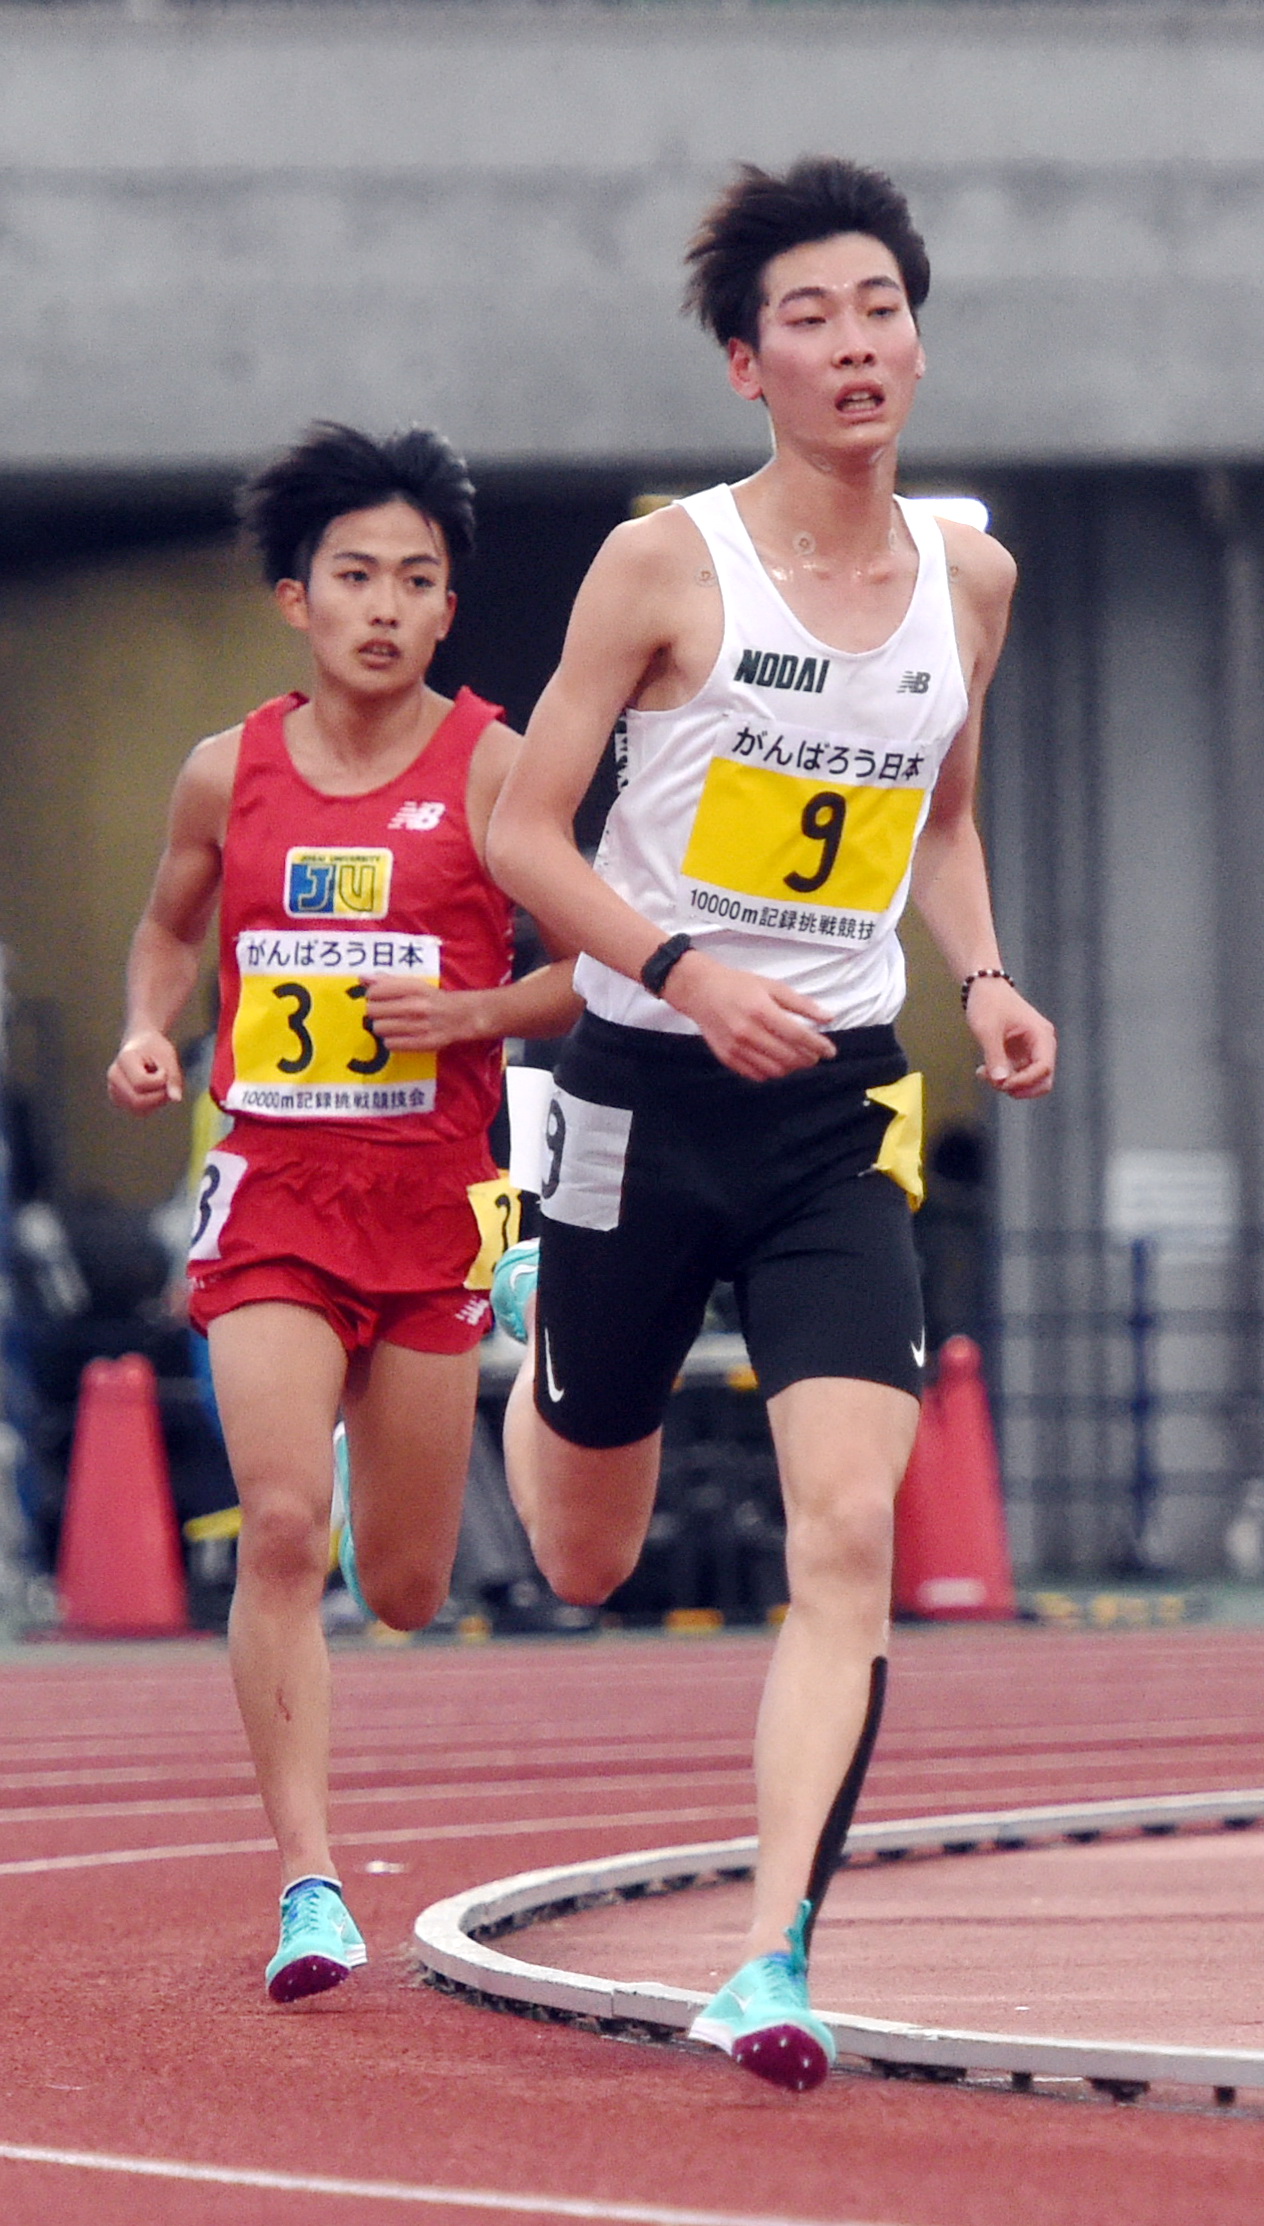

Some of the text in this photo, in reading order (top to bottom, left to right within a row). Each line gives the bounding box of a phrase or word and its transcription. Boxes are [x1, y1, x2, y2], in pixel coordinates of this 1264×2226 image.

[734, 649, 830, 693] NODAI
[732, 726, 925, 781] がんばろう日本
[783, 791, 847, 893] 9
[298, 864, 375, 912] JU
[247, 940, 423, 968] がんばろう日本
[272, 982, 390, 1075] 33
